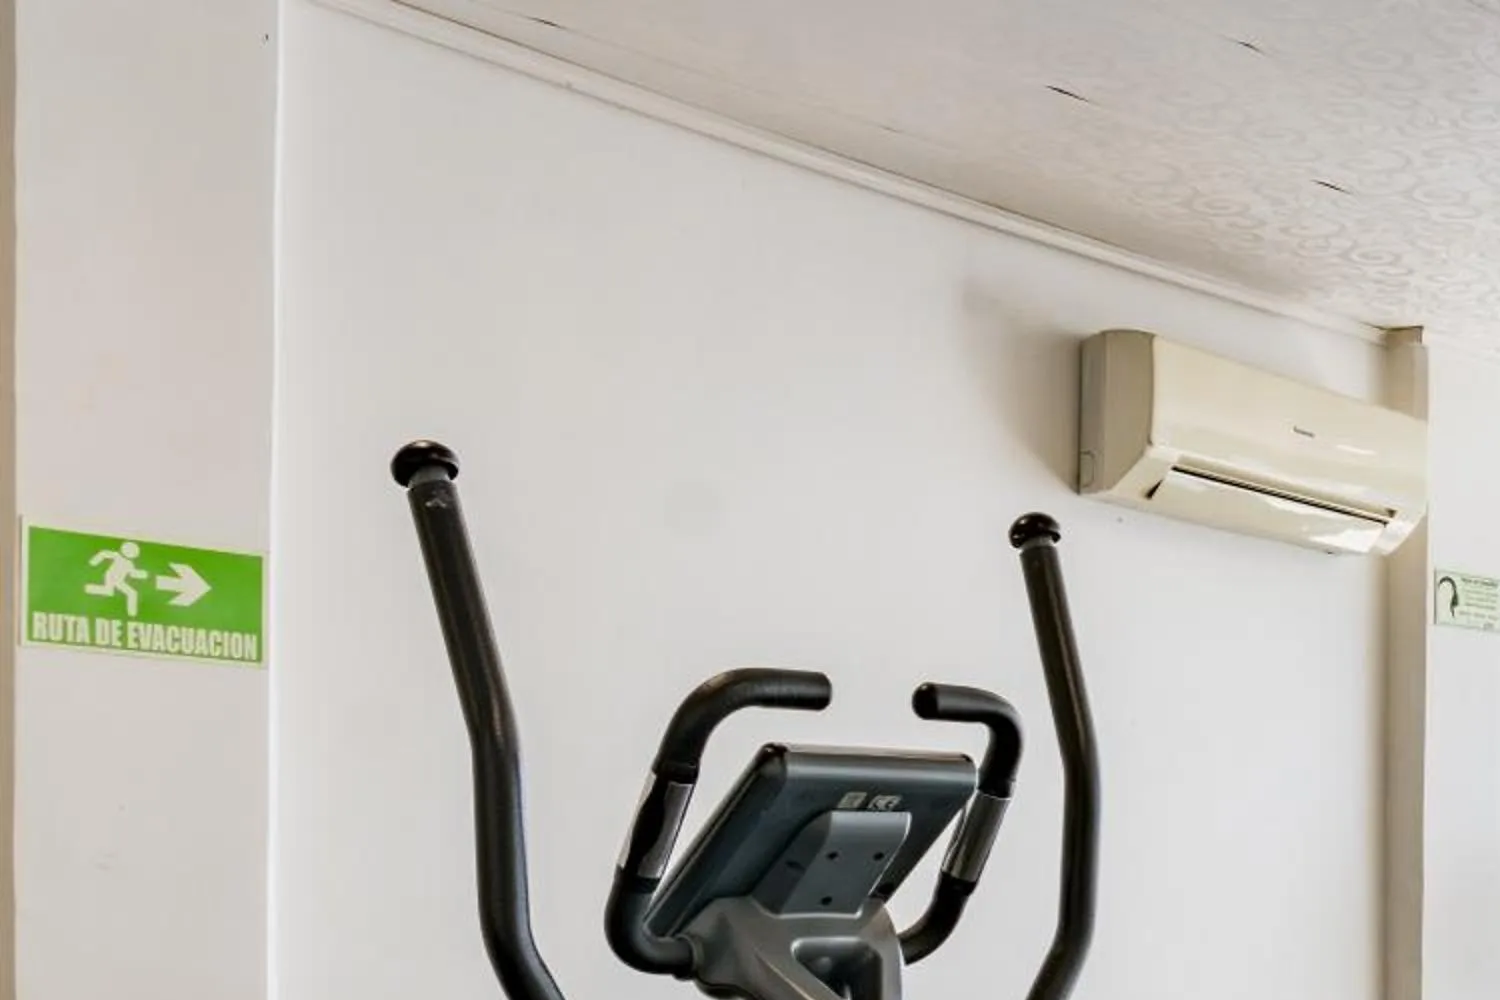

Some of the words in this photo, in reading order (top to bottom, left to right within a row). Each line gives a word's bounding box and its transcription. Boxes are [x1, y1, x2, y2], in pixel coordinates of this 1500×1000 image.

[32, 611, 90, 645] RUTA
[96, 617, 122, 647] DE
[127, 621, 257, 661] EVACUACION
